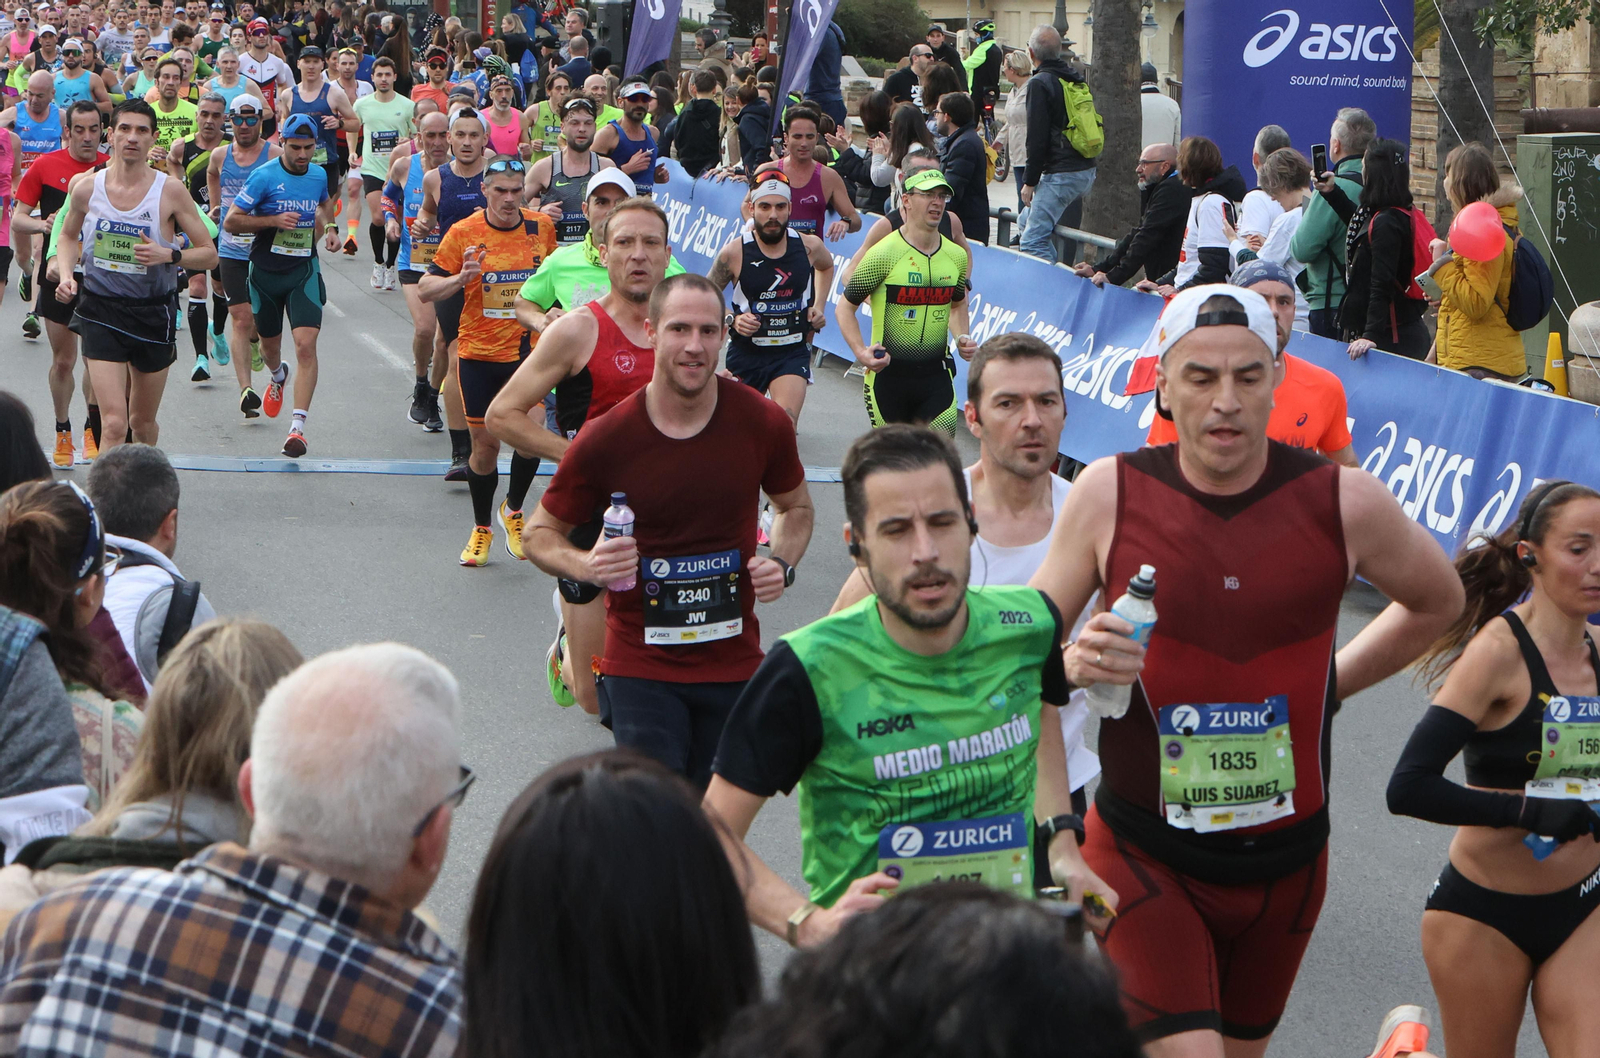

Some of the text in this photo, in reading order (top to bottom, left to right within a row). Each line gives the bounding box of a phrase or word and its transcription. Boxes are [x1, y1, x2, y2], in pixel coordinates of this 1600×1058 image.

[1299, 23, 1398, 62] asics
[1290, 75, 1407, 91] sound mind, sound body
[693, 213, 728, 258] asics
[112, 239, 131, 250] 1544
[108, 252, 132, 262] PERICO
[500, 272, 531, 281] ZURICH
[500, 288, 519, 297] 4377
[769, 301, 797, 311] ZURICH
[769, 317, 788, 326] 2390
[1386, 437, 1475, 534] asics
[676, 556, 730, 573] ZURICH
[677, 587, 711, 604] 2340
[999, 610, 1033, 624] 2023
[857, 714, 916, 740] HOKA
[1208, 710, 1270, 728] ZURIC
[873, 713, 1032, 781] MEDIO MARATÓN
[1208, 751, 1258, 770] 1835
[1183, 779, 1280, 803] LUIS SUAREZ
[933, 823, 1013, 849] ZURICH
